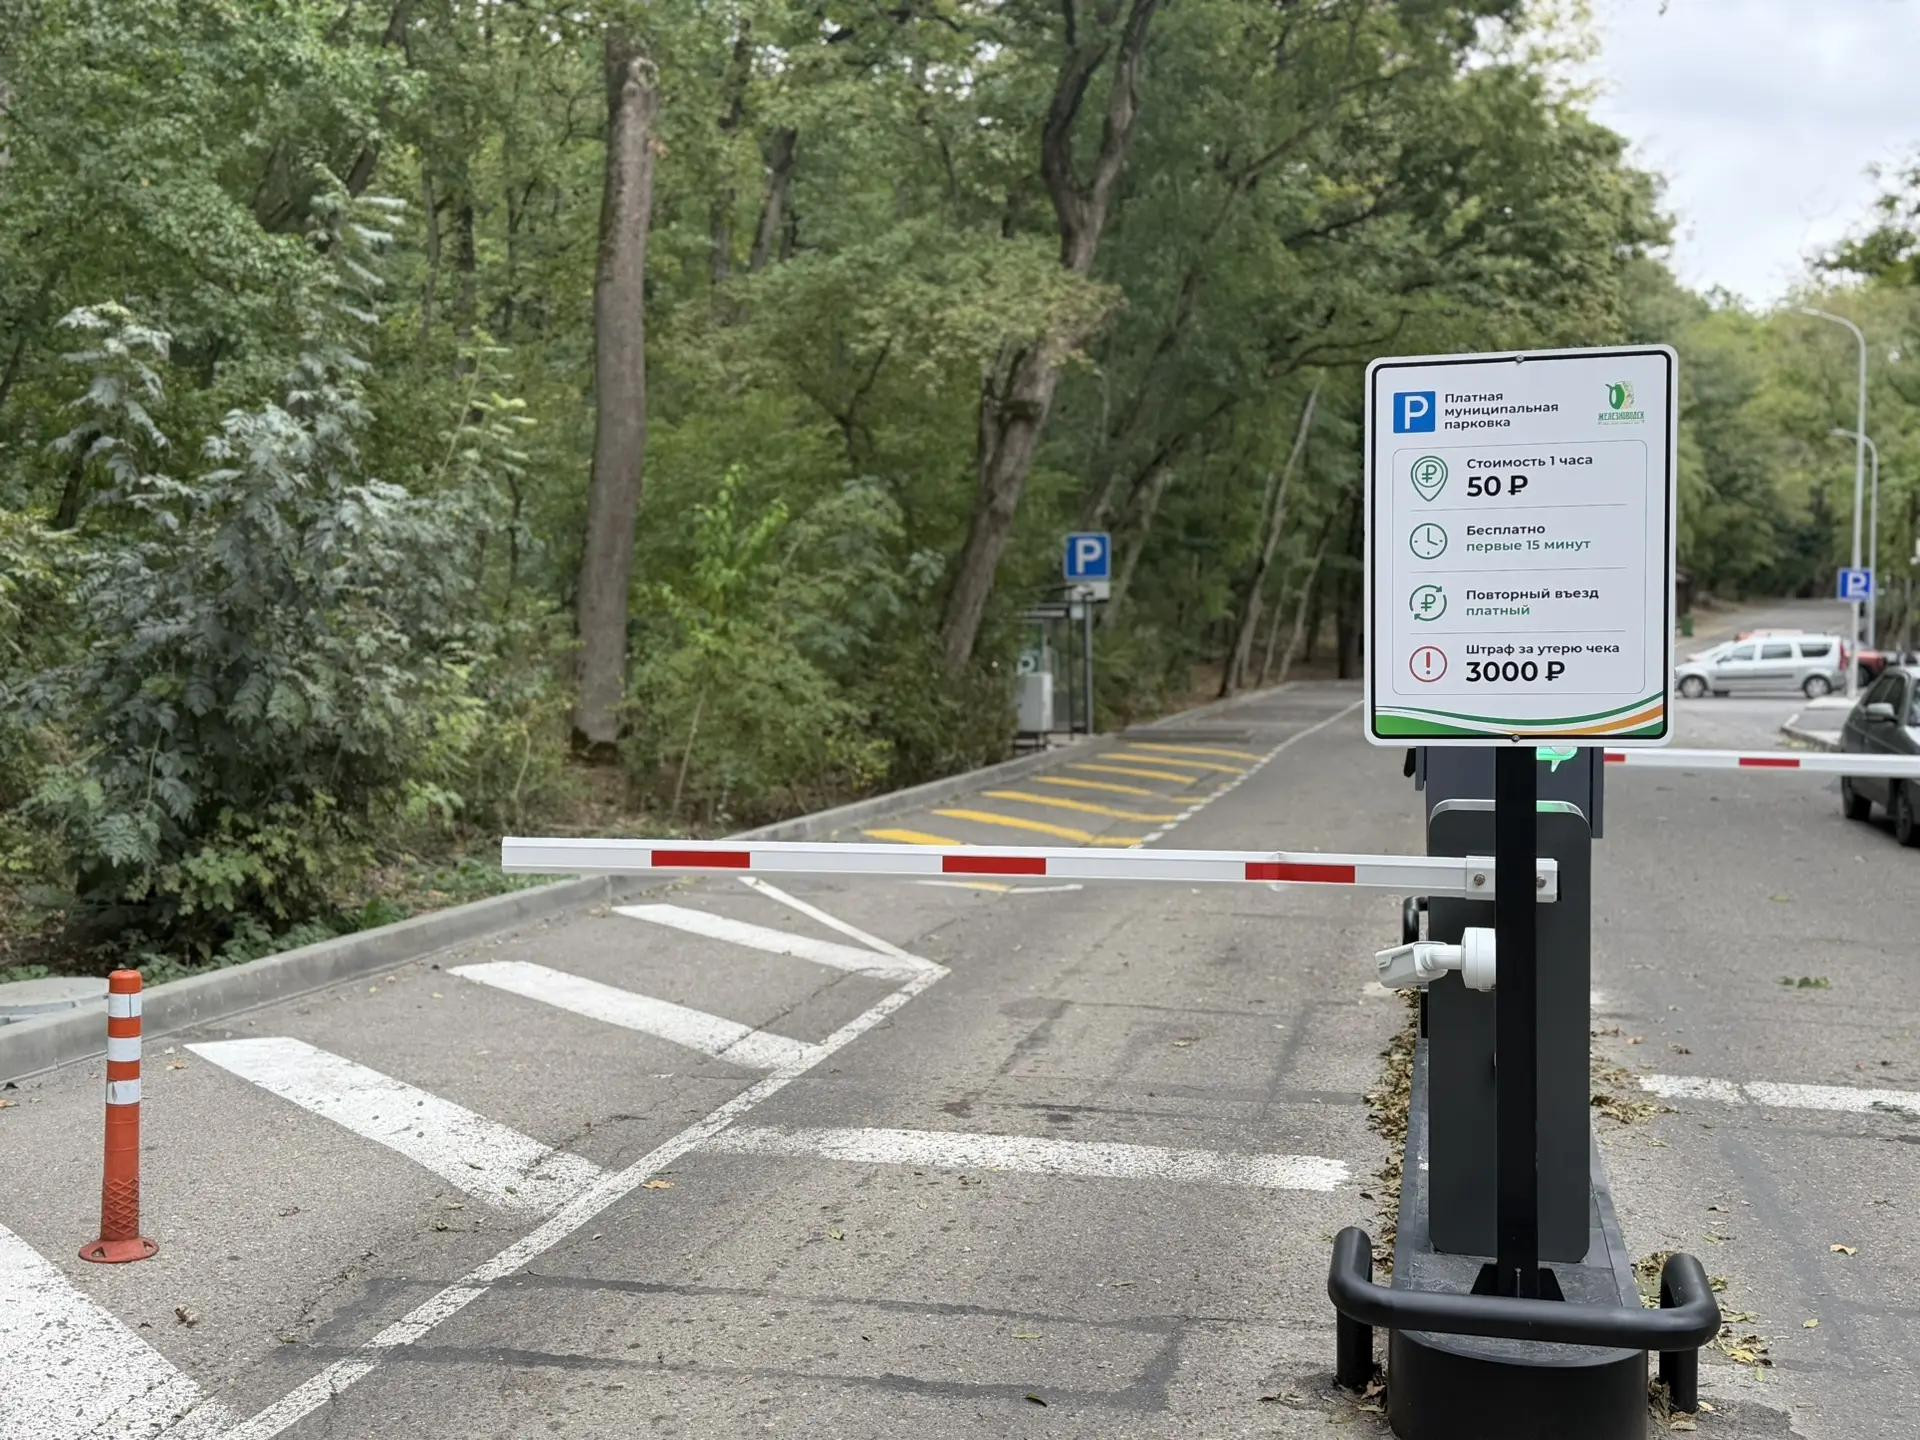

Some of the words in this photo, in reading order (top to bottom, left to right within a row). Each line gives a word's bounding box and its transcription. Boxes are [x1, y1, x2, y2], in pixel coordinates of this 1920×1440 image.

[1444, 392, 1504, 404] Платная
[1404, 395, 1429, 430] P
[1444, 403, 1559, 419] муниципальная
[1444, 419, 1511, 432] парковка
[1466, 458, 1547, 470] Стоимость
[1549, 455, 1556, 467] 1
[1558, 456, 1594, 466] часа
[1466, 475, 1502, 498] 50
[1466, 525, 1546, 537] Бесплатно
[1466, 542, 1523, 554] первые
[1525, 539, 1541, 551] 15
[1544, 540, 1591, 552] минут
[1075, 538, 1103, 576] P
[1466, 588, 1551, 602] Повторный
[1554, 589, 1600, 600] въезд
[1466, 604, 1531, 617] платный
[1466, 644, 1516, 656] Штраф
[1518, 645, 1535, 655] за
[1537, 645, 1583, 657] утерю
[1585, 644, 1620, 654] чека
[1465, 660, 1539, 683] 3000
